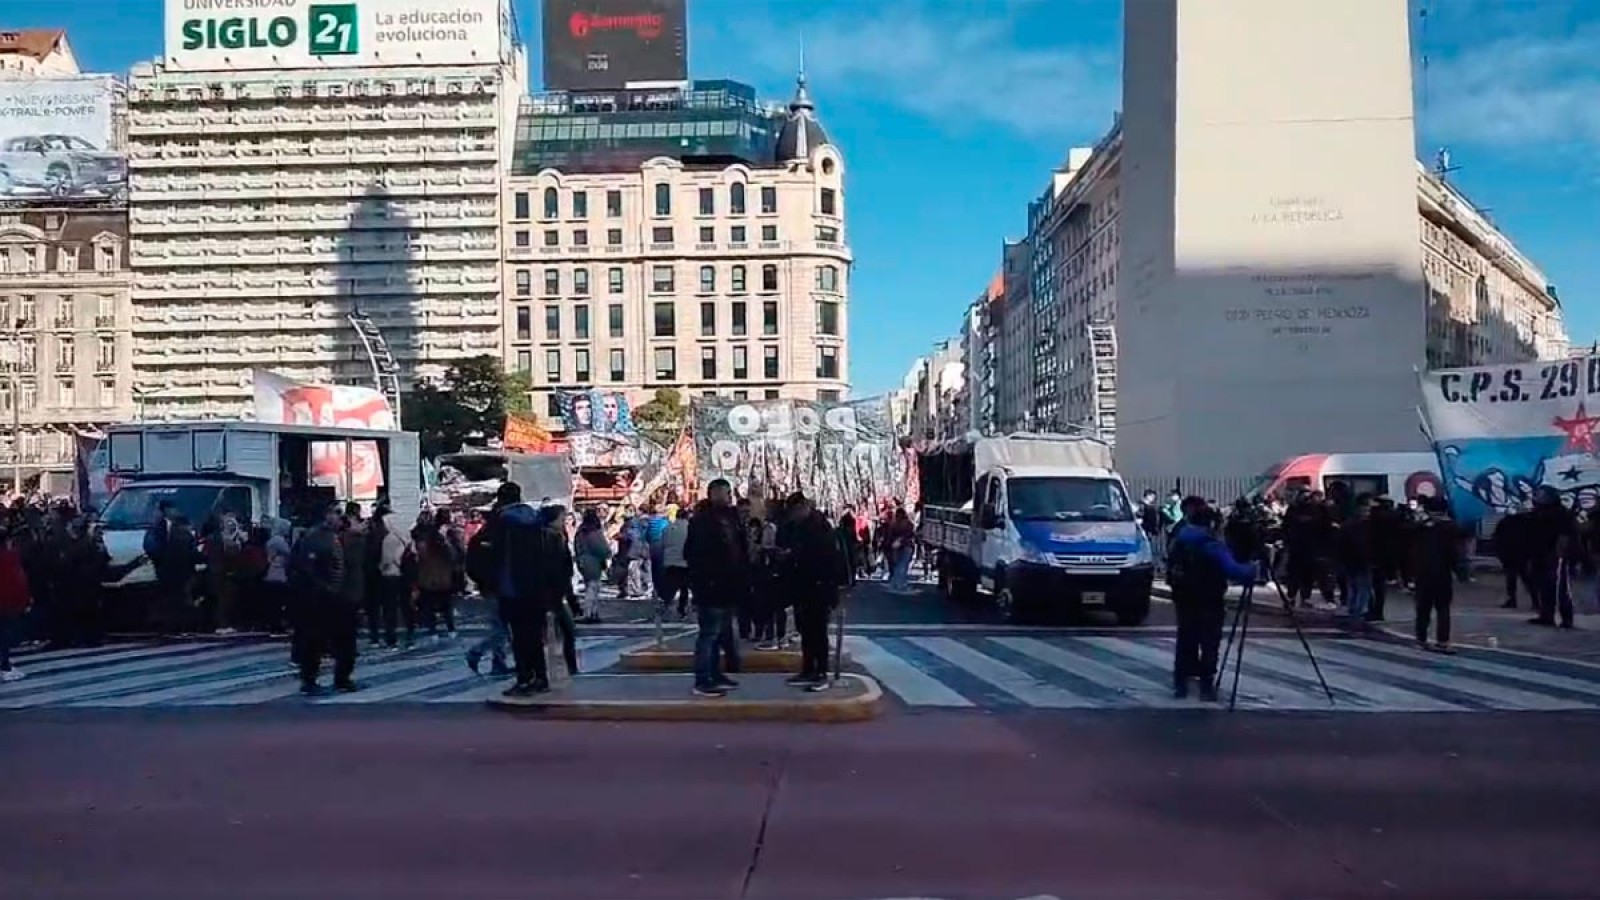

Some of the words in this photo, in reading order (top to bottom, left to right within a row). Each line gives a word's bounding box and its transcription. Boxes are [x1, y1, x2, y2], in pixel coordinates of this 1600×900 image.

[375, 12, 393, 25] La
[400, 8, 483, 25] educación
[182, 16, 298, 50] SIGLO
[315, 13, 352, 51] 21
[375, 26, 468, 42] evoluciona
[43, 106, 95, 116] e-POWER
[1440, 368, 1530, 403] C.P.S.
[1540, 362, 1578, 400] 29
